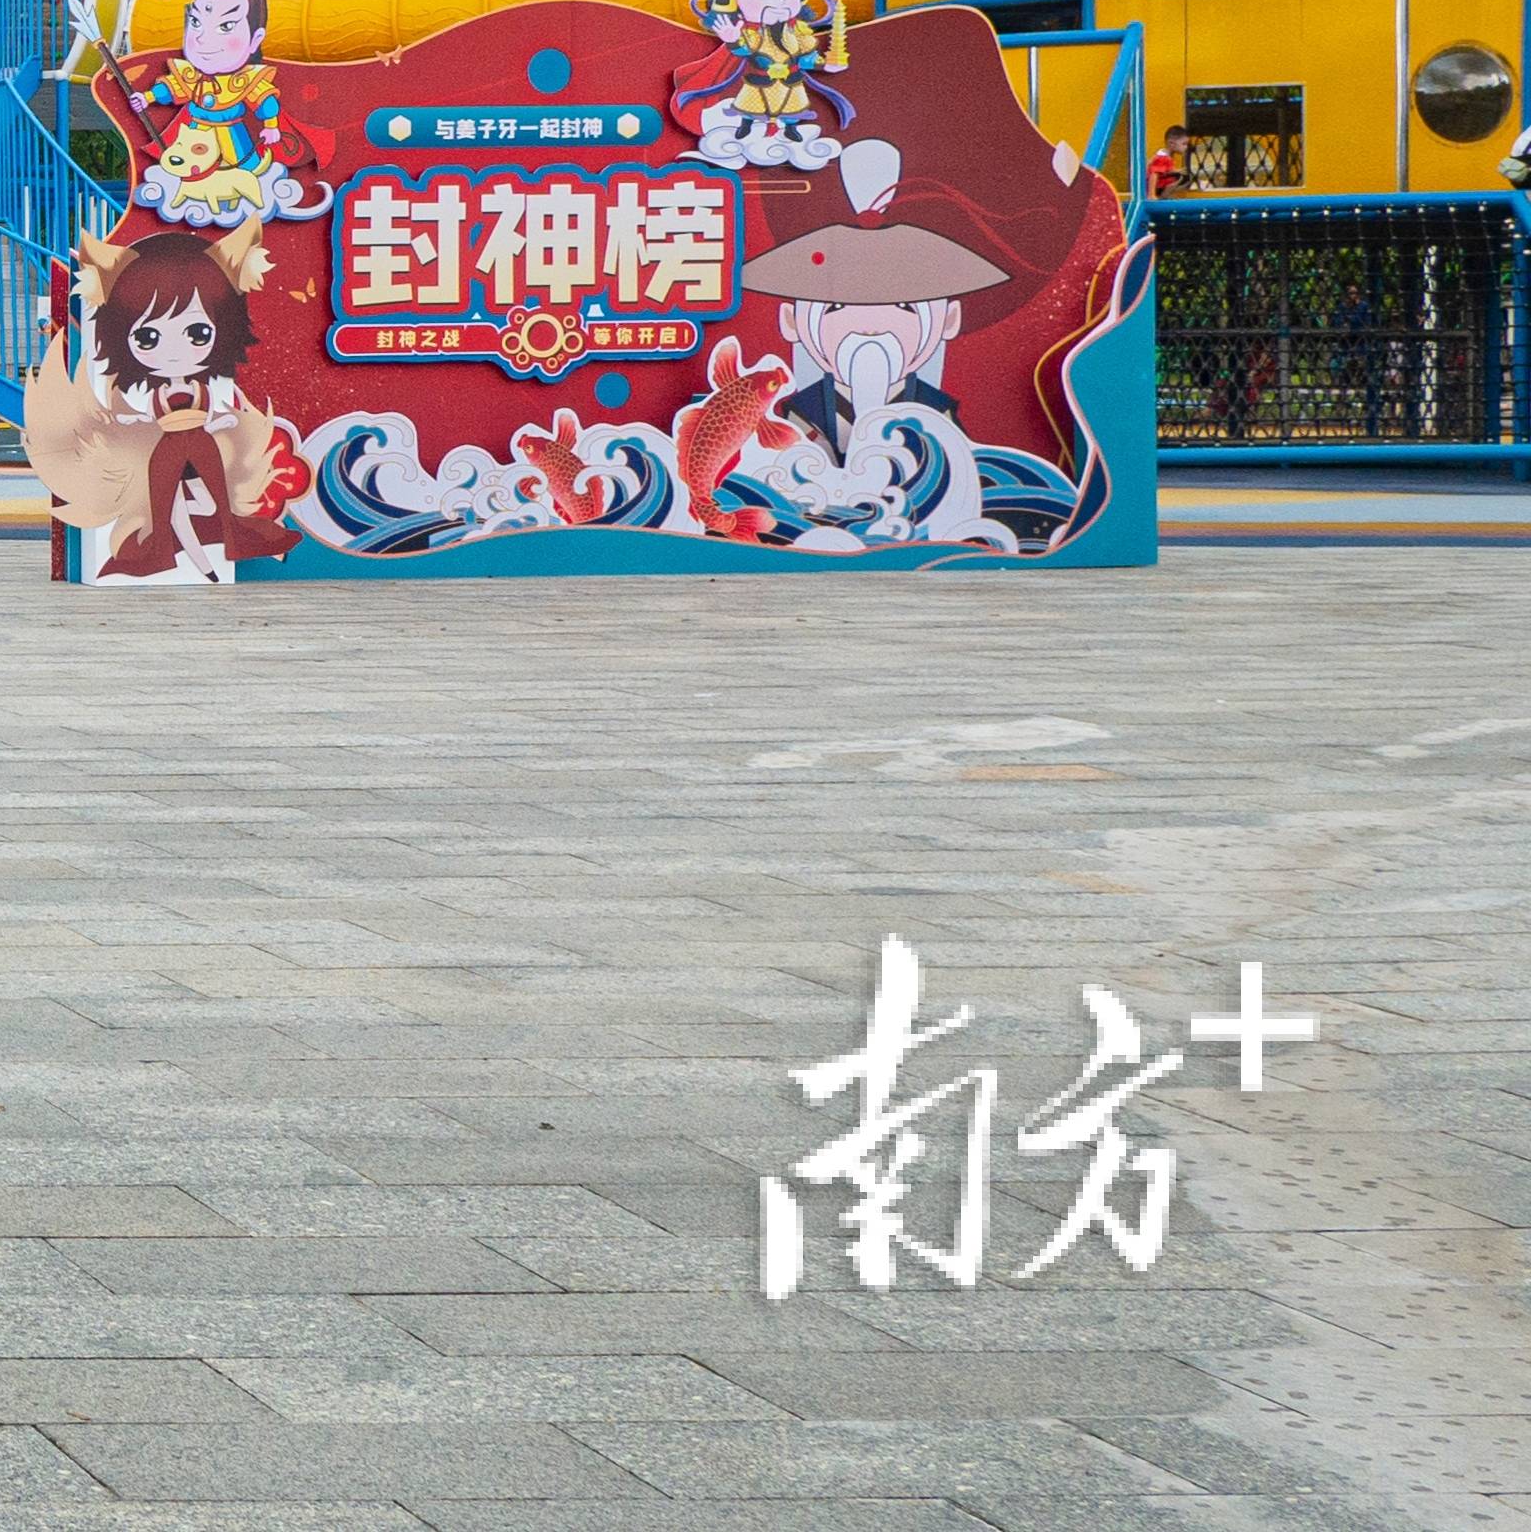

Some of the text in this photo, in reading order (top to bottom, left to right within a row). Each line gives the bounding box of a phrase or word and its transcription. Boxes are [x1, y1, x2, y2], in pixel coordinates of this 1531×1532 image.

[434, 117, 604, 141] 与姜子牙一起封神
[351, 180, 725, 307] 封神榜
[375, 329, 461, 349] 封神之战
